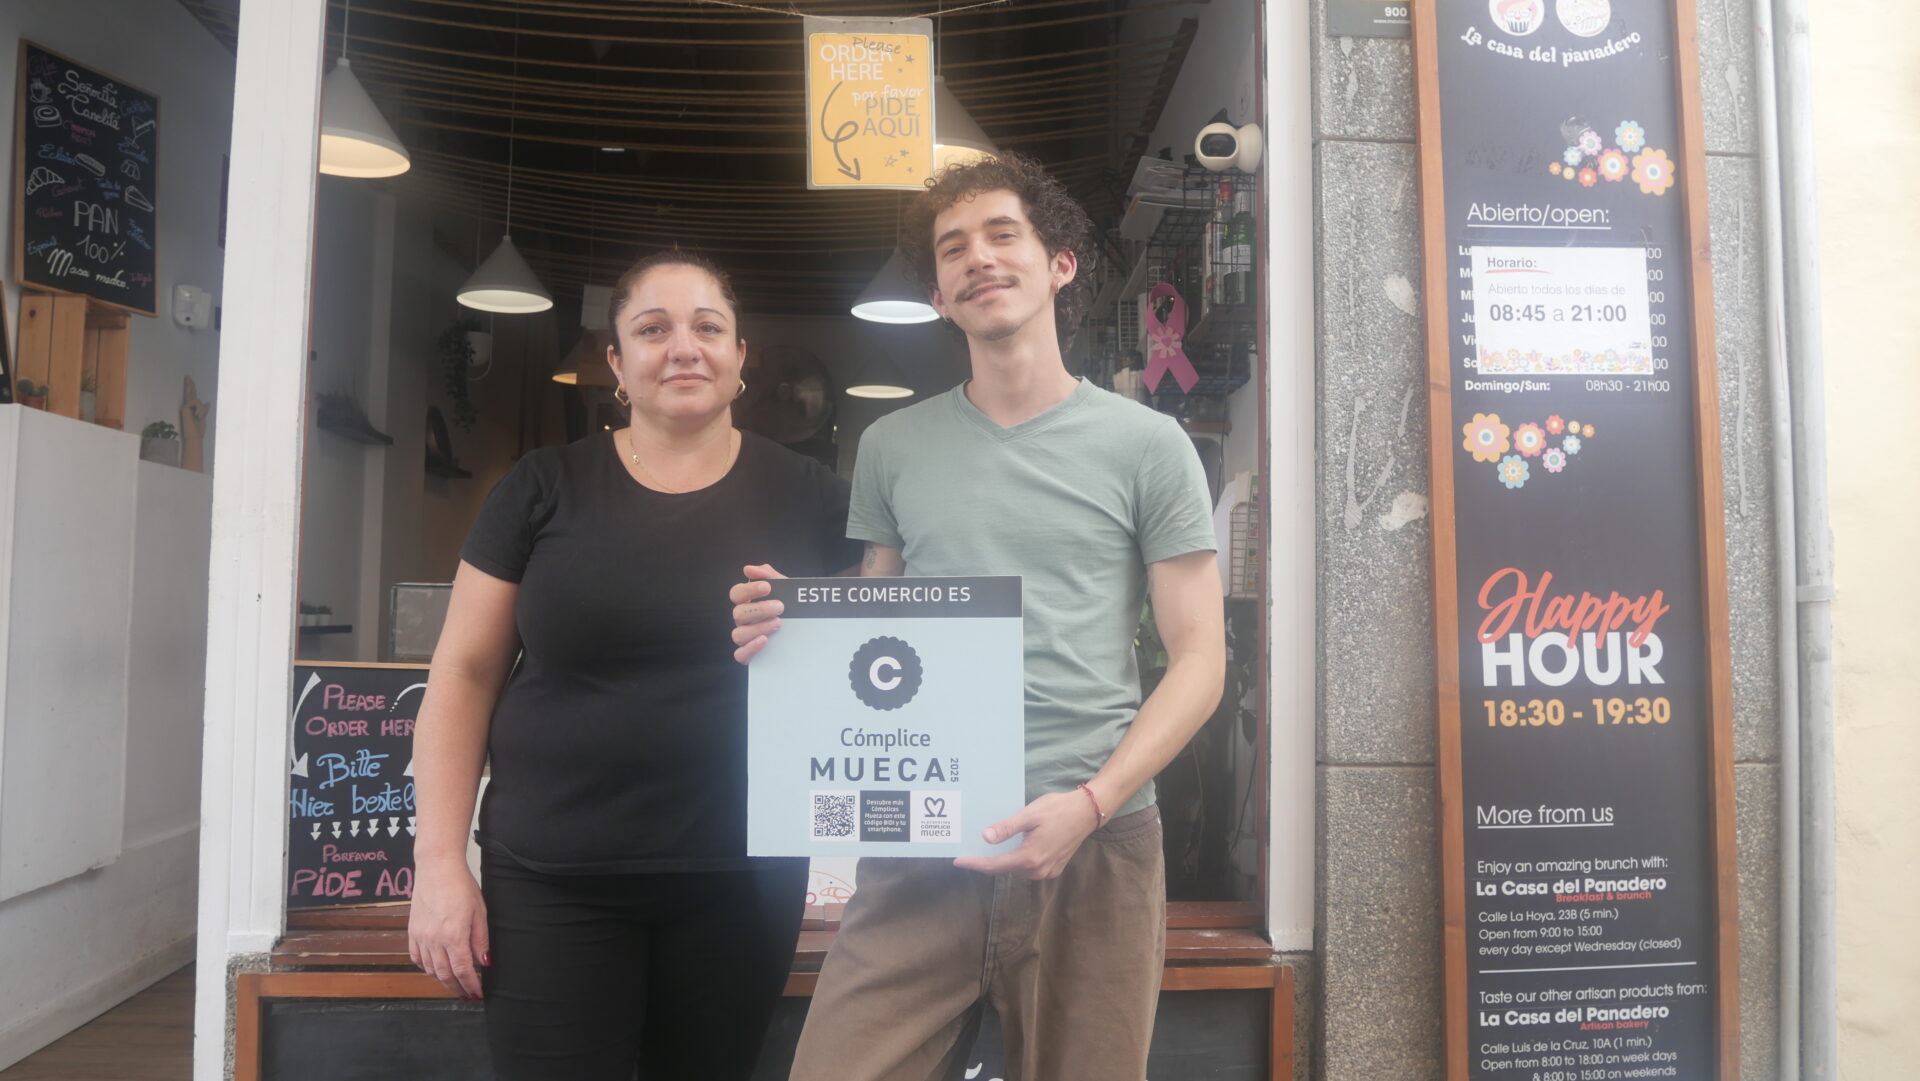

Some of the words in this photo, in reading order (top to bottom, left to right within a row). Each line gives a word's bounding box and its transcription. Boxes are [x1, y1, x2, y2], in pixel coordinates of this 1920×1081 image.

[1384, 6, 1407, 17] 900
[820, 44, 893, 63] ORDER
[852, 36, 901, 54] Please
[1460, 26, 1482, 46] La
[1487, 38, 1524, 59] casa
[1529, 46, 1556, 63] del
[1562, 32, 1640, 67] panadero
[831, 64, 884, 81] HERE
[852, 91, 876, 107] por
[881, 85, 924, 104] favor
[865, 97, 917, 116] PIDE
[74, 201, 119, 235] PAN
[1467, 203, 1610, 226] Abierto/open:
[76, 234, 127, 264] 100%
[1487, 257, 1537, 269] Horario:
[1488, 283, 1528, 295] Abierto
[1531, 283, 1562, 296] todos
[1565, 283, 1581, 296] los
[1611, 283, 1626, 296] de
[1490, 304, 1546, 322] 08:45
[1553, 308, 1564, 322] a
[1571, 305, 1627, 322] 21:00
[1465, 380, 1551, 394] Domingo/Sun:
[1586, 380, 1623, 392] 08h30
[1634, 380, 1670, 392] 21h00
[797, 587, 841, 603] ESTE
[847, 587, 942, 602] COMERCIO
[948, 586, 971, 602] ES
[1477, 567, 1670, 649] Happy
[1482, 631, 1665, 687] HOUR
[869, 656, 903, 691] C
[322, 683, 386, 711] PLEASE
[1484, 699, 1564, 727] 18:30
[1592, 697, 1671, 725] 19:30
[305, 716, 370, 737] ORDER
[381, 718, 416, 737] HER
[840, 728, 931, 752] Cómplice
[316, 749, 390, 790] Bitte
[810, 757, 946, 782] MUECA
[950, 758, 959, 783] 2025
[289, 788, 334, 819] Hier
[1477, 806, 1532, 824] More
[1538, 804, 1586, 823] from
[1592, 806, 1614, 822] us
[1477, 860, 1511, 875] Enjoy
[1515, 862, 1533, 873] an
[1536, 859, 1591, 874] amazing
[1595, 857, 1638, 871] brunch
[1641, 856, 1669, 868] with:
[375, 867, 415, 898] AQ
[1476, 881, 1497, 896] La
[1501, 880, 1548, 896] Casa
[1552, 879, 1580, 894] del
[1584, 876, 1667, 893] Panadero
[1555, 892, 1603, 903] Breakfast
[1606, 892, 1614, 901] &
[1616, 891, 1652, 901] brunch
[1478, 911, 1508, 923] Calle
[1510, 910, 1524, 922] La
[1526, 910, 1556, 922] Hoya,
[1558, 909, 1578, 920] 23B
[1579, 908, 1591, 922] (5
[1593, 908, 1619, 920] min.)
[1478, 929, 1511, 942] Open
[1513, 928, 1538, 939] from
[1540, 927, 1561, 938] 9:00
[1563, 926, 1574, 937] to
[1577, 926, 1603, 937] 15:00
[1479, 946, 1509, 957] every
[1511, 943, 1532, 956] day
[1535, 943, 1572, 955] except
[1574, 939, 1637, 953] Wednesday
[1639, 937, 1682, 951] (closed)
[1479, 991, 1513, 1004] Taste
[1515, 993, 1536, 1003] our
[1539, 989, 1572, 1002] other
[1575, 987, 1616, 1001] artisan
[1619, 983, 1674, 1001] products
[1676, 982, 1708, 995] from:
[1480, 1012, 1499, 1027] La
[1504, 1010, 1550, 1026] Casa
[1555, 1008, 1582, 1023] del
[1586, 1005, 1669, 1022] Panadero
[1580, 1021, 1614, 1031] Artisan
[1616, 1019, 1649, 1030] bakery
[1481, 1043, 1510, 1055] Calle
[1512, 1042, 1531, 1053] Luis
[1533, 1040, 1548, 1052] de
[1550, 1039, 1561, 1051] la
[1592, 1038, 1611, 1049] 10A
[1613, 1037, 1623, 1050] (1
[1626, 1035, 1652, 1048] min.)
[1481, 1059, 1513, 1072] Open
[1515, 1057, 1539, 1068] from
[1541, 1056, 1562, 1067] 8:00
[1564, 1056, 1575, 1066] to
[1578, 1055, 1603, 1066] 18:00
[1606, 1055, 1620, 1064] on
[1622, 1052, 1650, 1063] week
[1652, 1050, 1677, 1063] days
[1532, 1073, 1541, 1081] &
[1543, 1071, 1564, 1081] 8:00
[1566, 1071, 1577, 1081] to
[1581, 1070, 1605, 1081] 15:00
[1608, 1069, 1622, 1079] on
[1624, 1066, 1676, 1078] weekends
